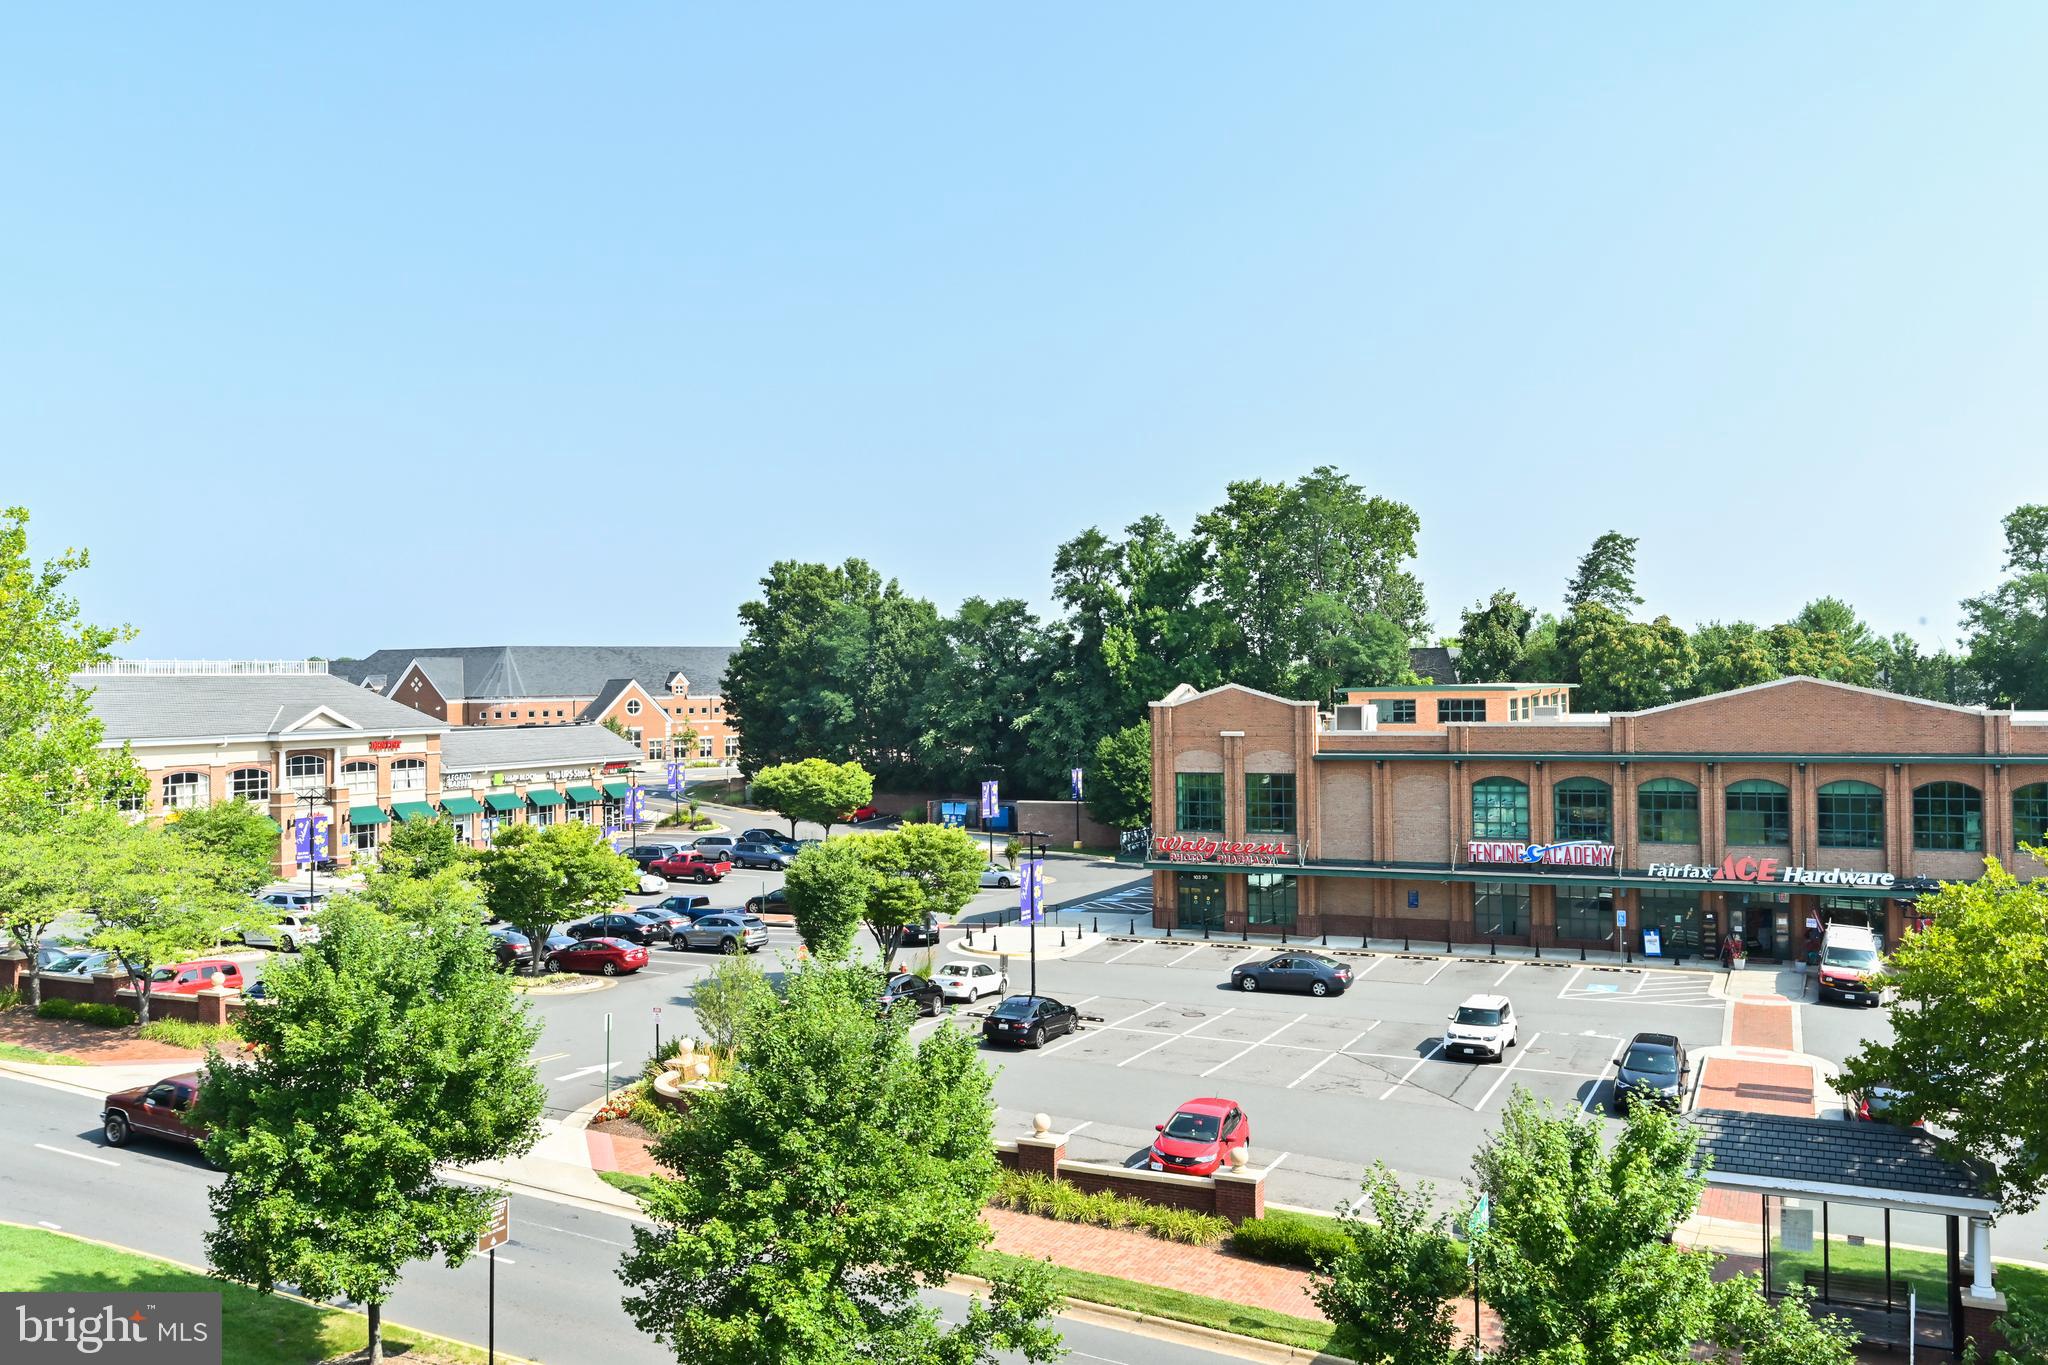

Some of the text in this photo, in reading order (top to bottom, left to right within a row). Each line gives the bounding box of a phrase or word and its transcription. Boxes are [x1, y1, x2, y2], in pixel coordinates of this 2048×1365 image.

[1154, 836, 1289, 858] Walgreens
[1170, 853, 1275, 865] PHOTO PHARMACY
[1467, 841, 1615, 867] FENCING ACADEMY
[1648, 852, 1895, 886] Fairfax ACE Hardware
